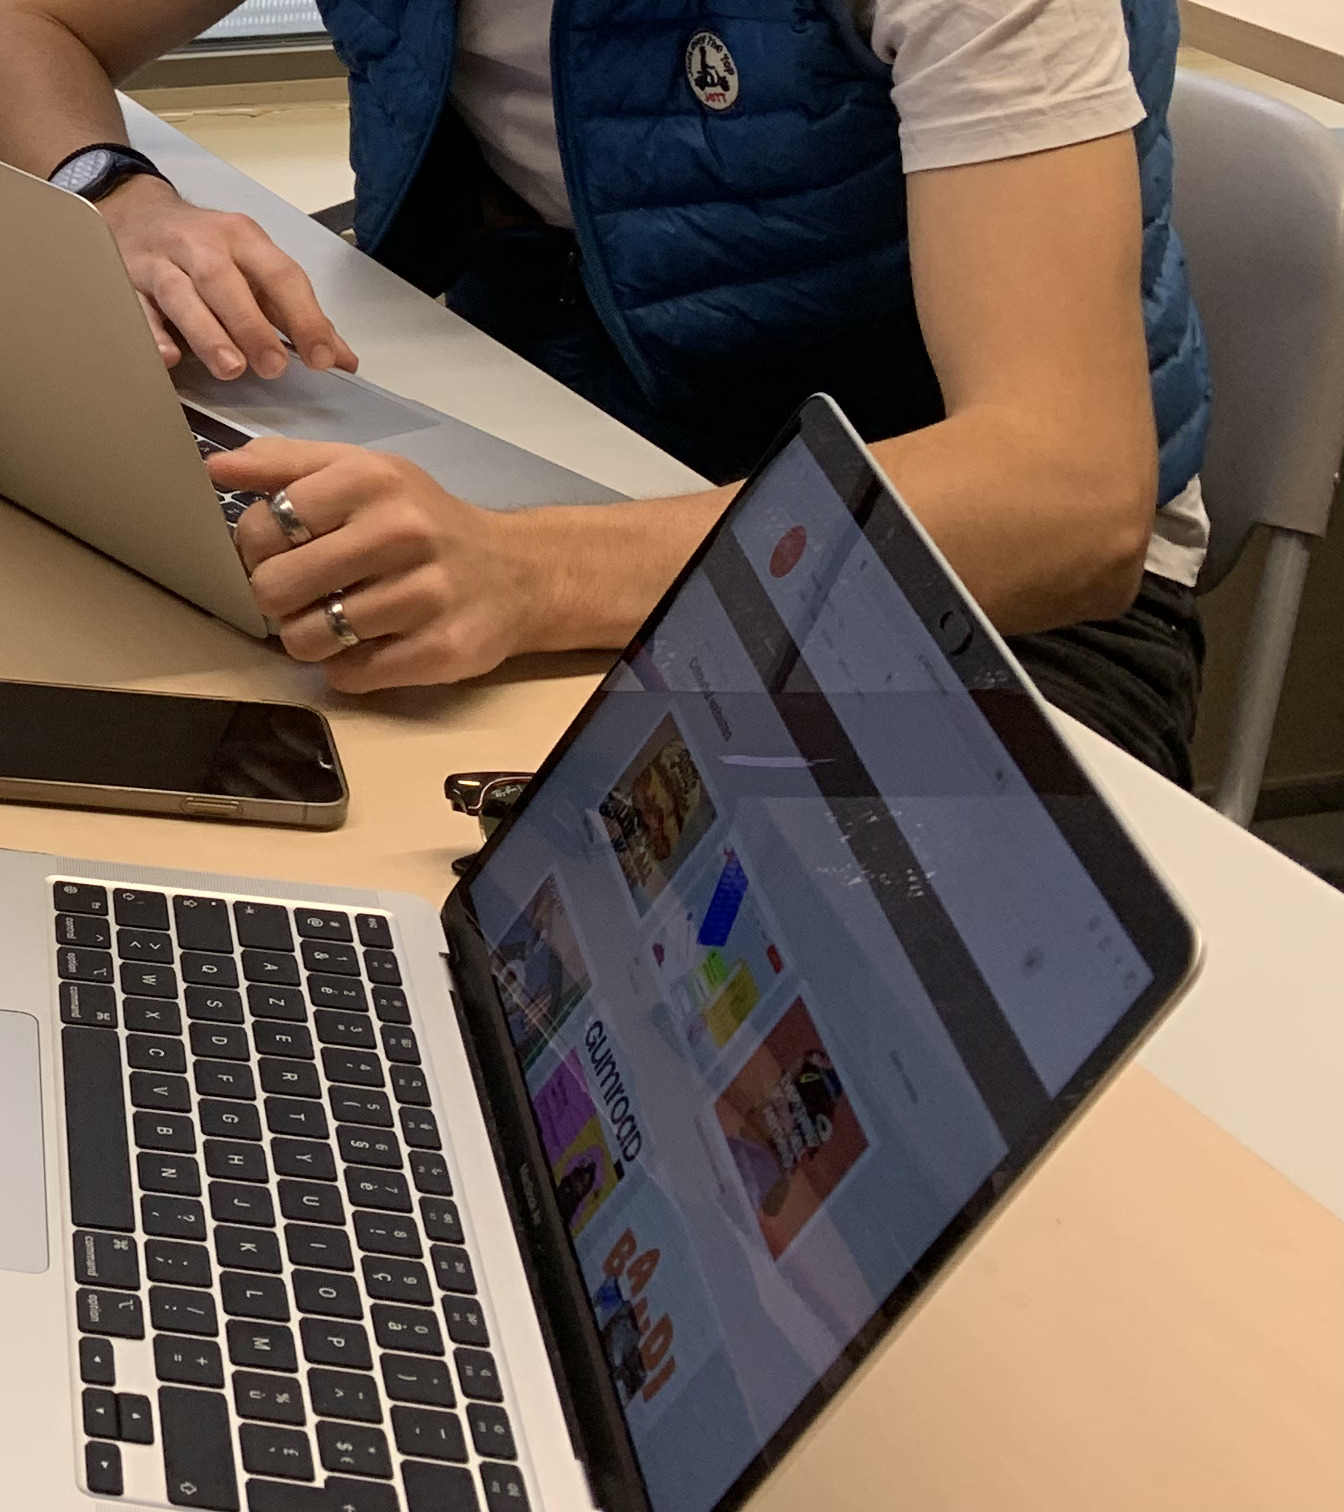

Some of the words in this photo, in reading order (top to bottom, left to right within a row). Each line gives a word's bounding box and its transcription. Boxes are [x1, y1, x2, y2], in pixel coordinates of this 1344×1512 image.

[65, 951, 79, 974] option
[262, 961, 279, 971] A
[200, 964, 218, 974] Q
[141, 974, 157, 986] W
[69, 984, 82, 1019] command
[206, 999, 224, 1009] S
[268, 997, 286, 1007] Z
[144, 1010, 161, 1020] X
[211, 1035, 228, 1046] D
[275, 1034, 292, 1043] E
[148, 1047, 165, 1057] C
[216, 1073, 234, 1083] F
[281, 1071, 299, 1082] R
[152, 1086, 169, 1096] V
[221, 1113, 240, 1124] G
[288, 1112, 306, 1122] T
[156, 1126, 174, 1136] B
[227, 1154, 245, 1166] H
[295, 1153, 313, 1163] Y
[160, 1167, 178, 1180] N
[366, 1103, 381, 1111] 5
[393, 1228, 408, 1239] 8
[402, 1276, 418, 1285] 9
[233, 1197, 251, 1208] J
[302, 1195, 320, 1207] U
[239, 1242, 258, 1253] K
[84, 1235, 99, 1278] command
[245, 1289, 264, 1299] L
[318, 1286, 337, 1299] O
[86, 1293, 102, 1323] option
[251, 1336, 272, 1351] M
[326, 1335, 346, 1348] P
